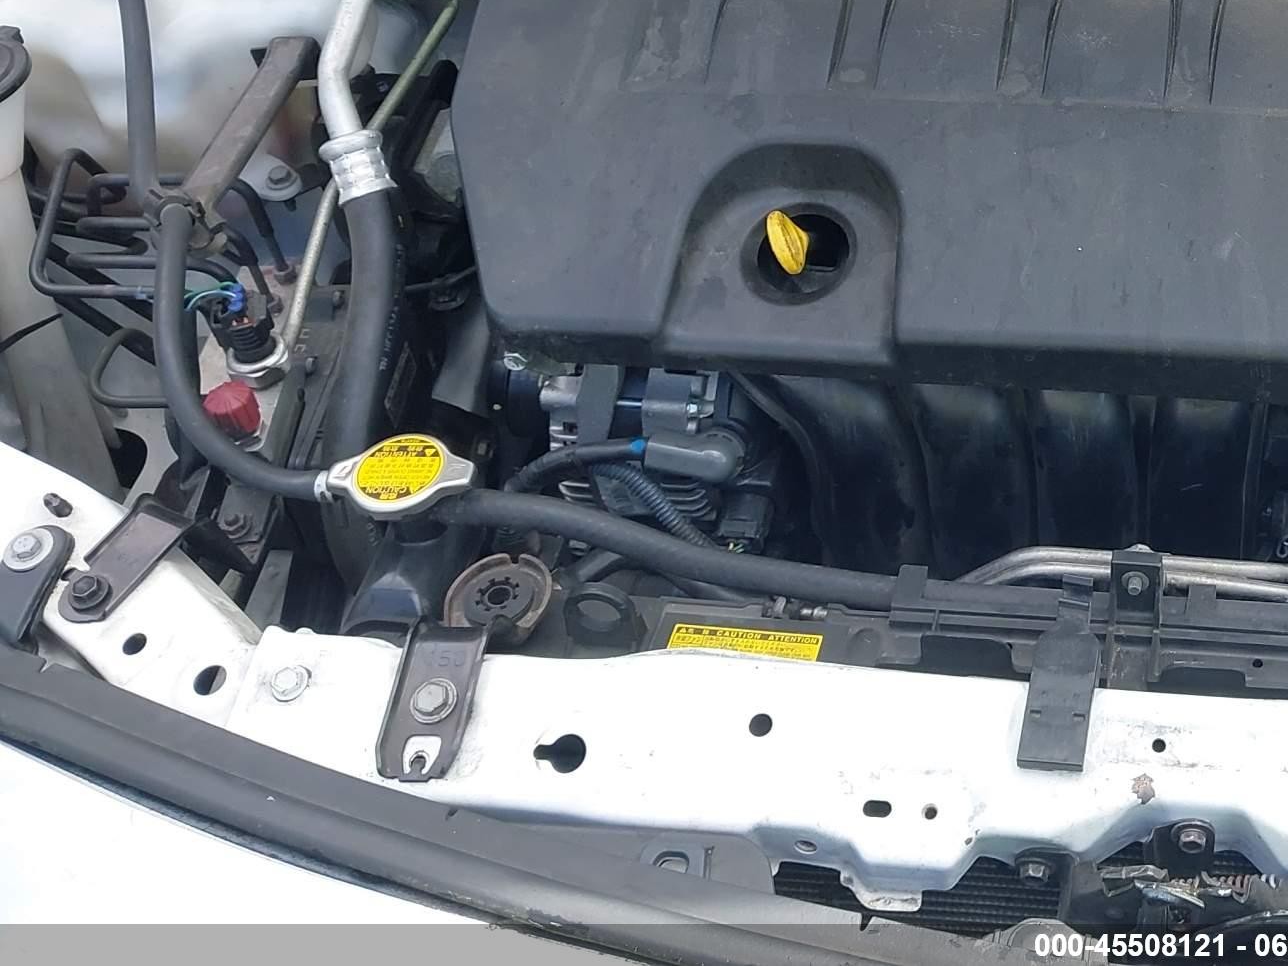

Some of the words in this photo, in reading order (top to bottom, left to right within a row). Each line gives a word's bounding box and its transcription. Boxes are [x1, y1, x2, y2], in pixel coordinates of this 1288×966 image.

[366, 486, 408, 494] CAUTION
[716, 628, 761, 640] CAUTION
[768, 634, 818, 644] ATTENTION
